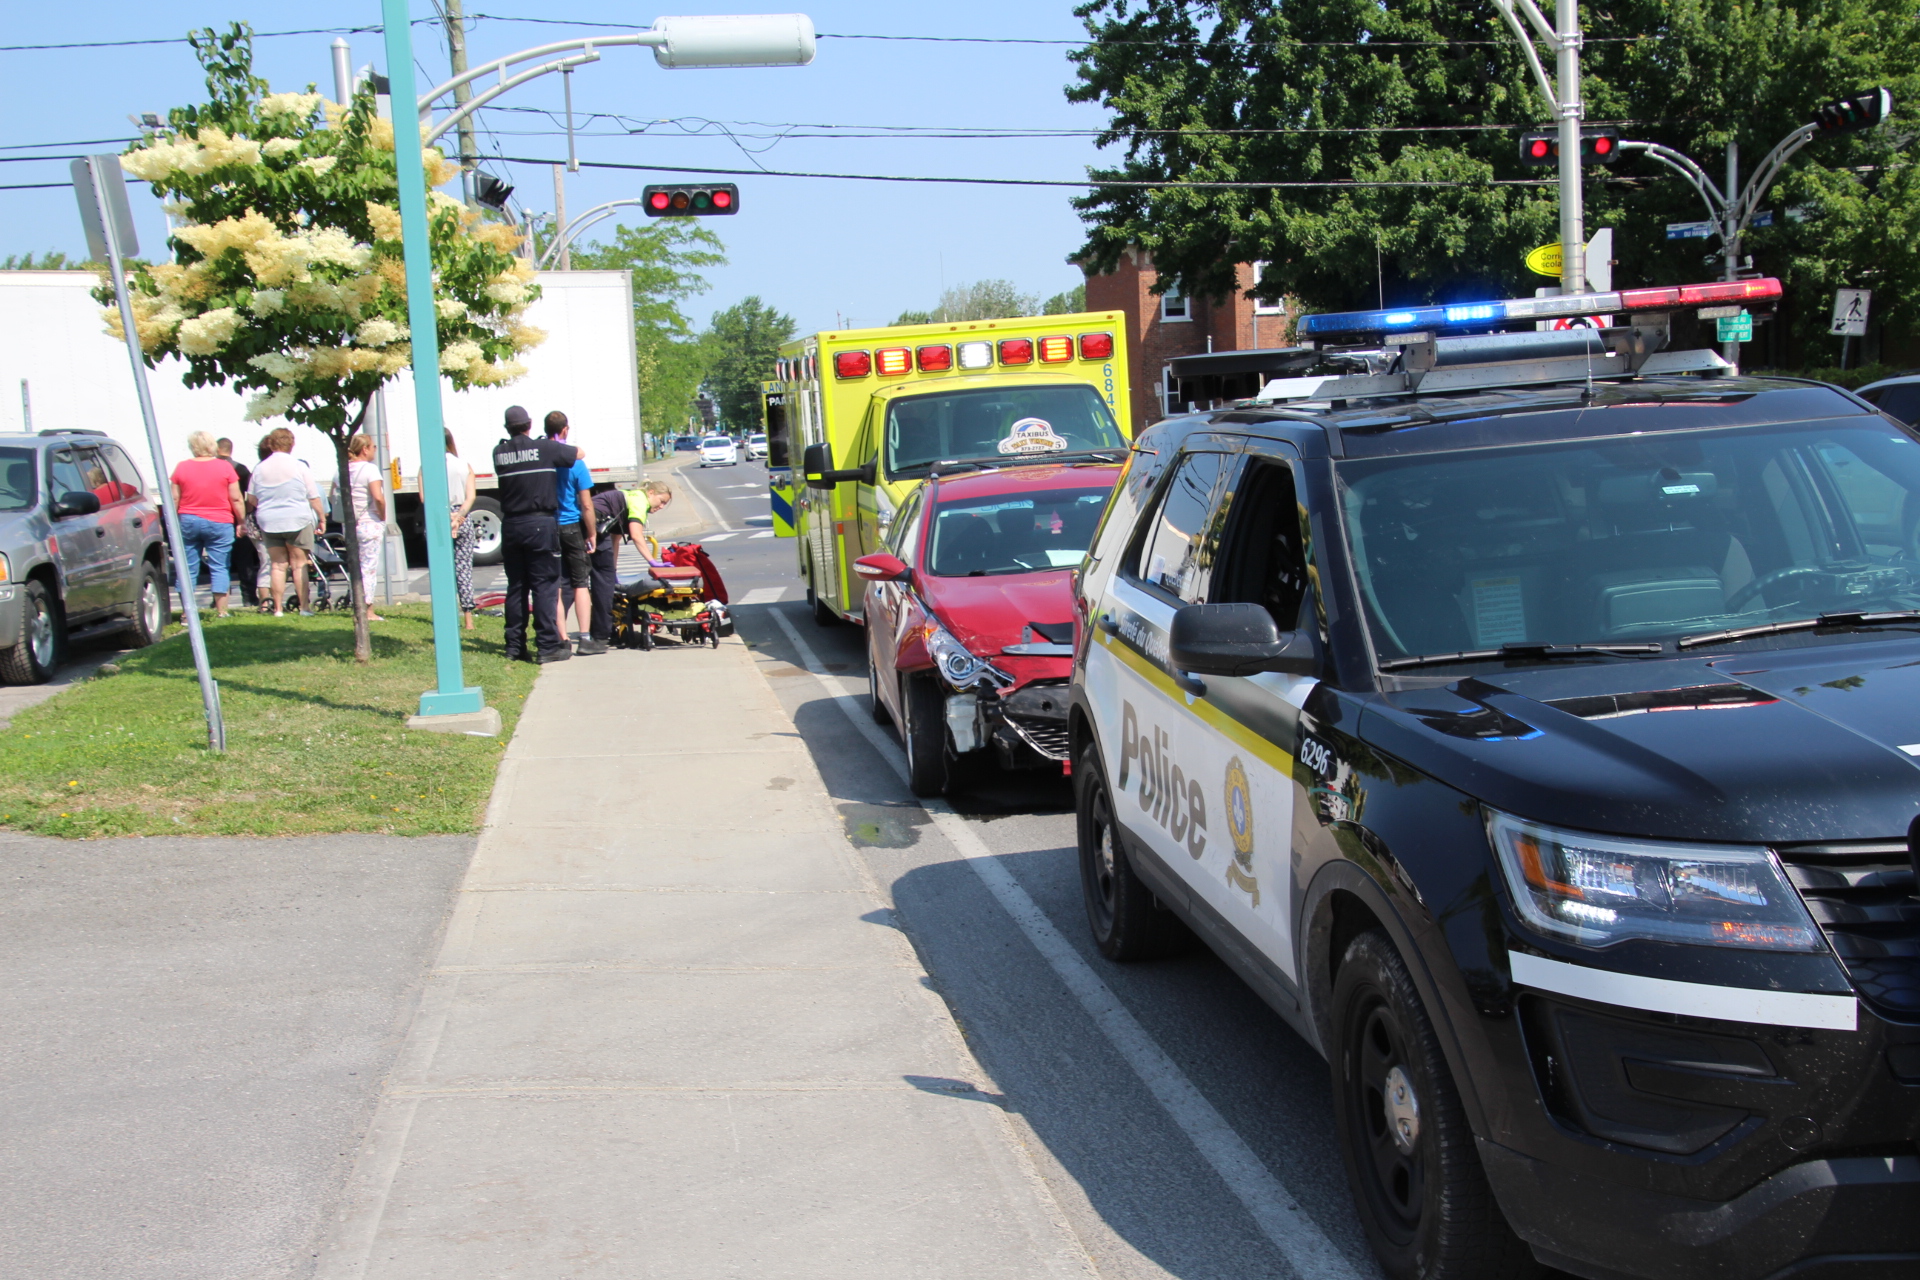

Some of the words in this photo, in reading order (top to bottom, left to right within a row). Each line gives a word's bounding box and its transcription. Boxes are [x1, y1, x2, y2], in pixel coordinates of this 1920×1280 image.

[1541, 252, 1562, 261] Corri
[1301, 738, 1331, 775] 6296
[1118, 698, 1208, 861] Police
